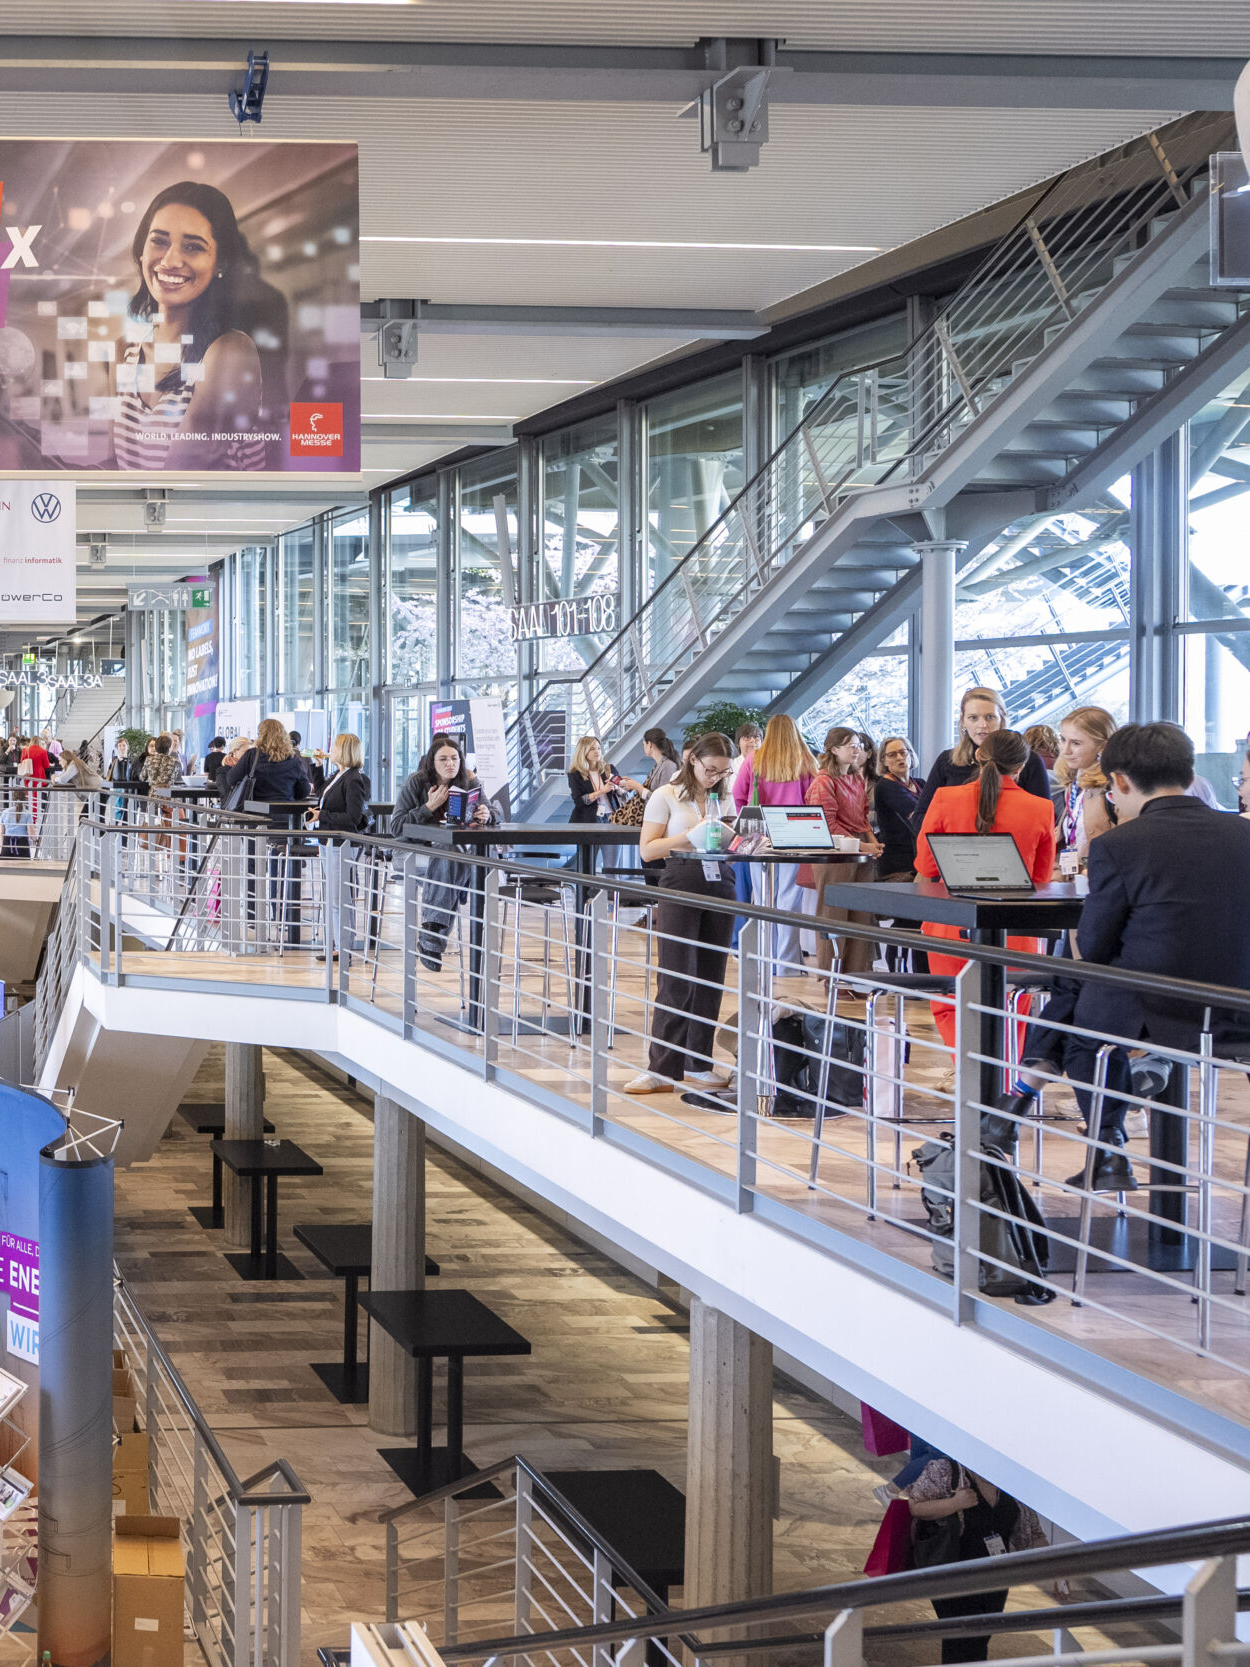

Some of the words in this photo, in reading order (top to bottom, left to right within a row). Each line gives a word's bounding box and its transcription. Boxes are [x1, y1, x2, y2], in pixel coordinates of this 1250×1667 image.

[135, 432, 169, 441] WORLD.
[171, 432, 210, 441] LEADING.
[211, 432, 282, 441] INDUSTRYSHOW.
[3, 556, 23, 564] finanz
[24, 556, 62, 564] informatik
[509, 604, 551, 640] SAAL
[1, 1234, 15, 1248] FÜR
[16, 1240, 34, 1257] ALLE,
[10, 1319, 39, 1355] WIR
